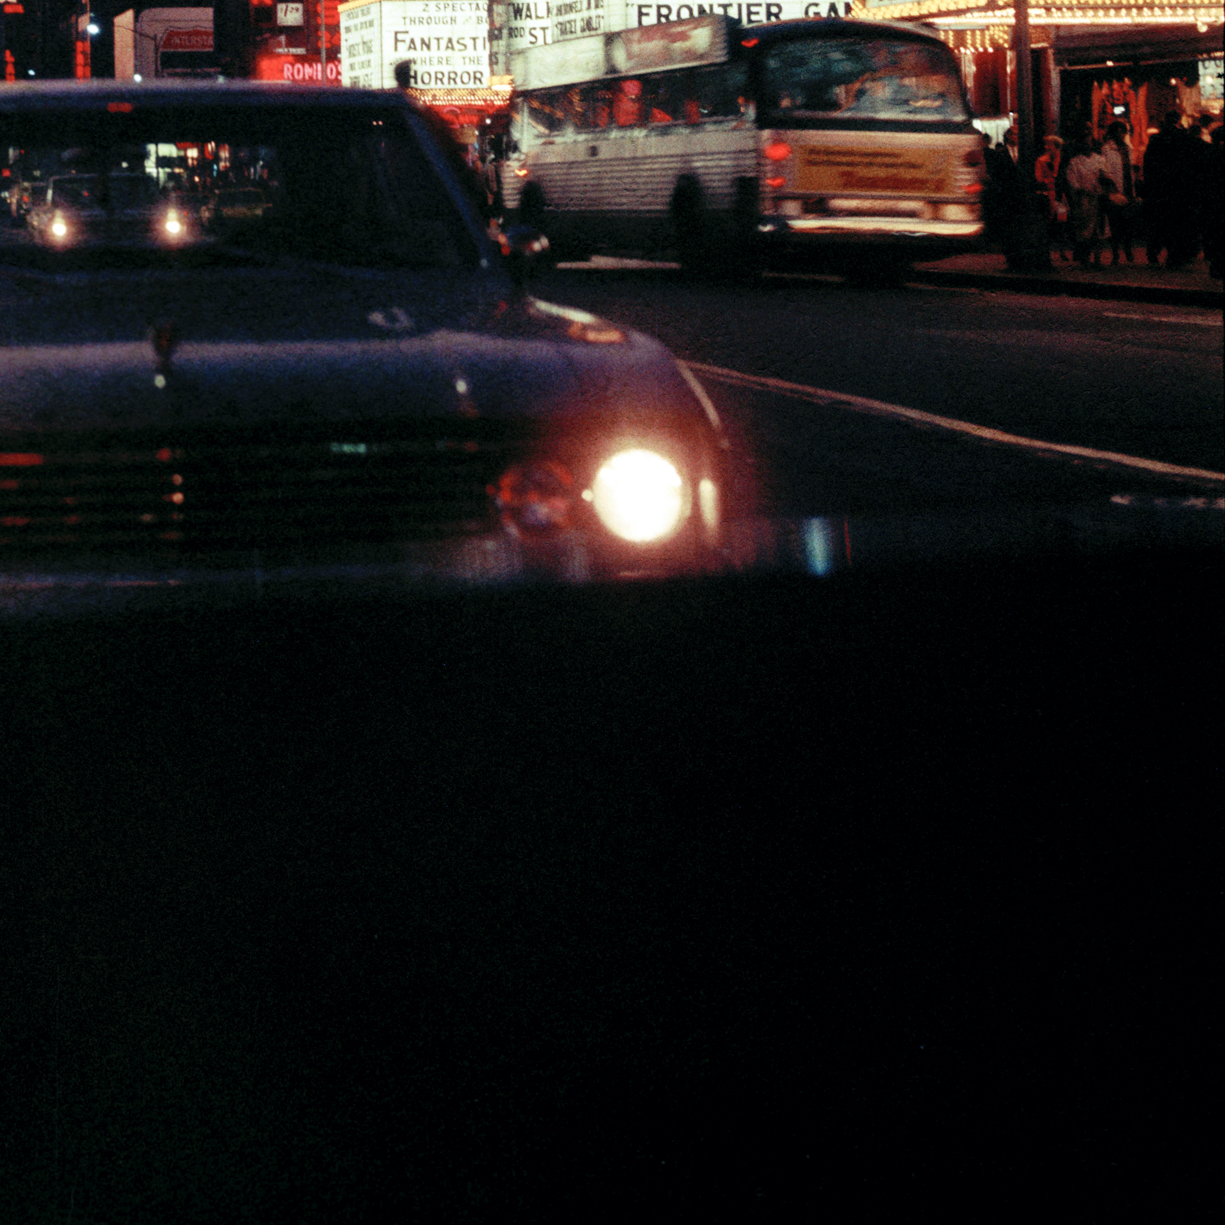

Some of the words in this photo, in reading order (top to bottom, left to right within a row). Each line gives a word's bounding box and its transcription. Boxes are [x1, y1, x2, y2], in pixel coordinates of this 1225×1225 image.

[402, 16, 457, 26] THROUGH
[394, 30, 487, 52] FANTASTI
[461, 56, 484, 66] THE
[411, 70, 485, 86] HORROR
